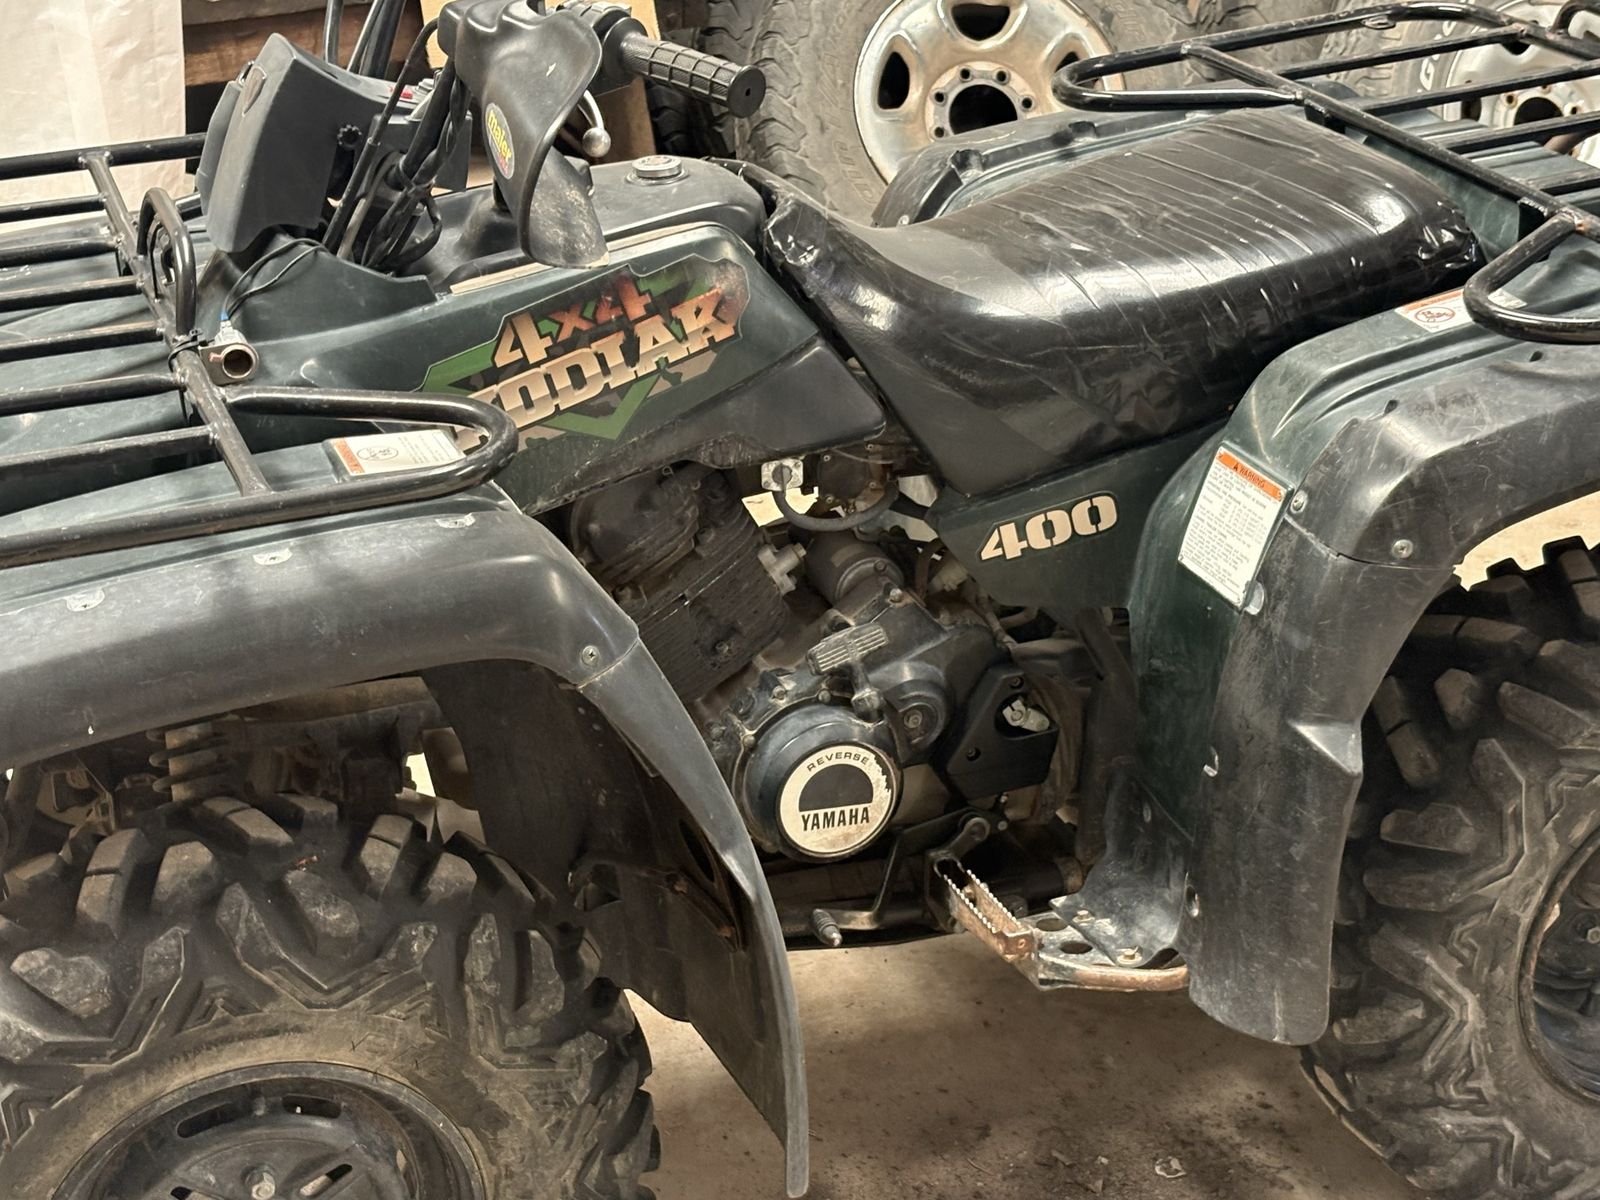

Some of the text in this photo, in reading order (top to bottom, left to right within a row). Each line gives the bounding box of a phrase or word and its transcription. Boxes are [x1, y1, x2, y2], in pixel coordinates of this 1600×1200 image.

[1238, 464, 1265, 489] WARNING
[981, 495, 1117, 560] 400
[806, 751, 870, 772] REVERSE
[801, 806, 870, 832] YAMAHA
